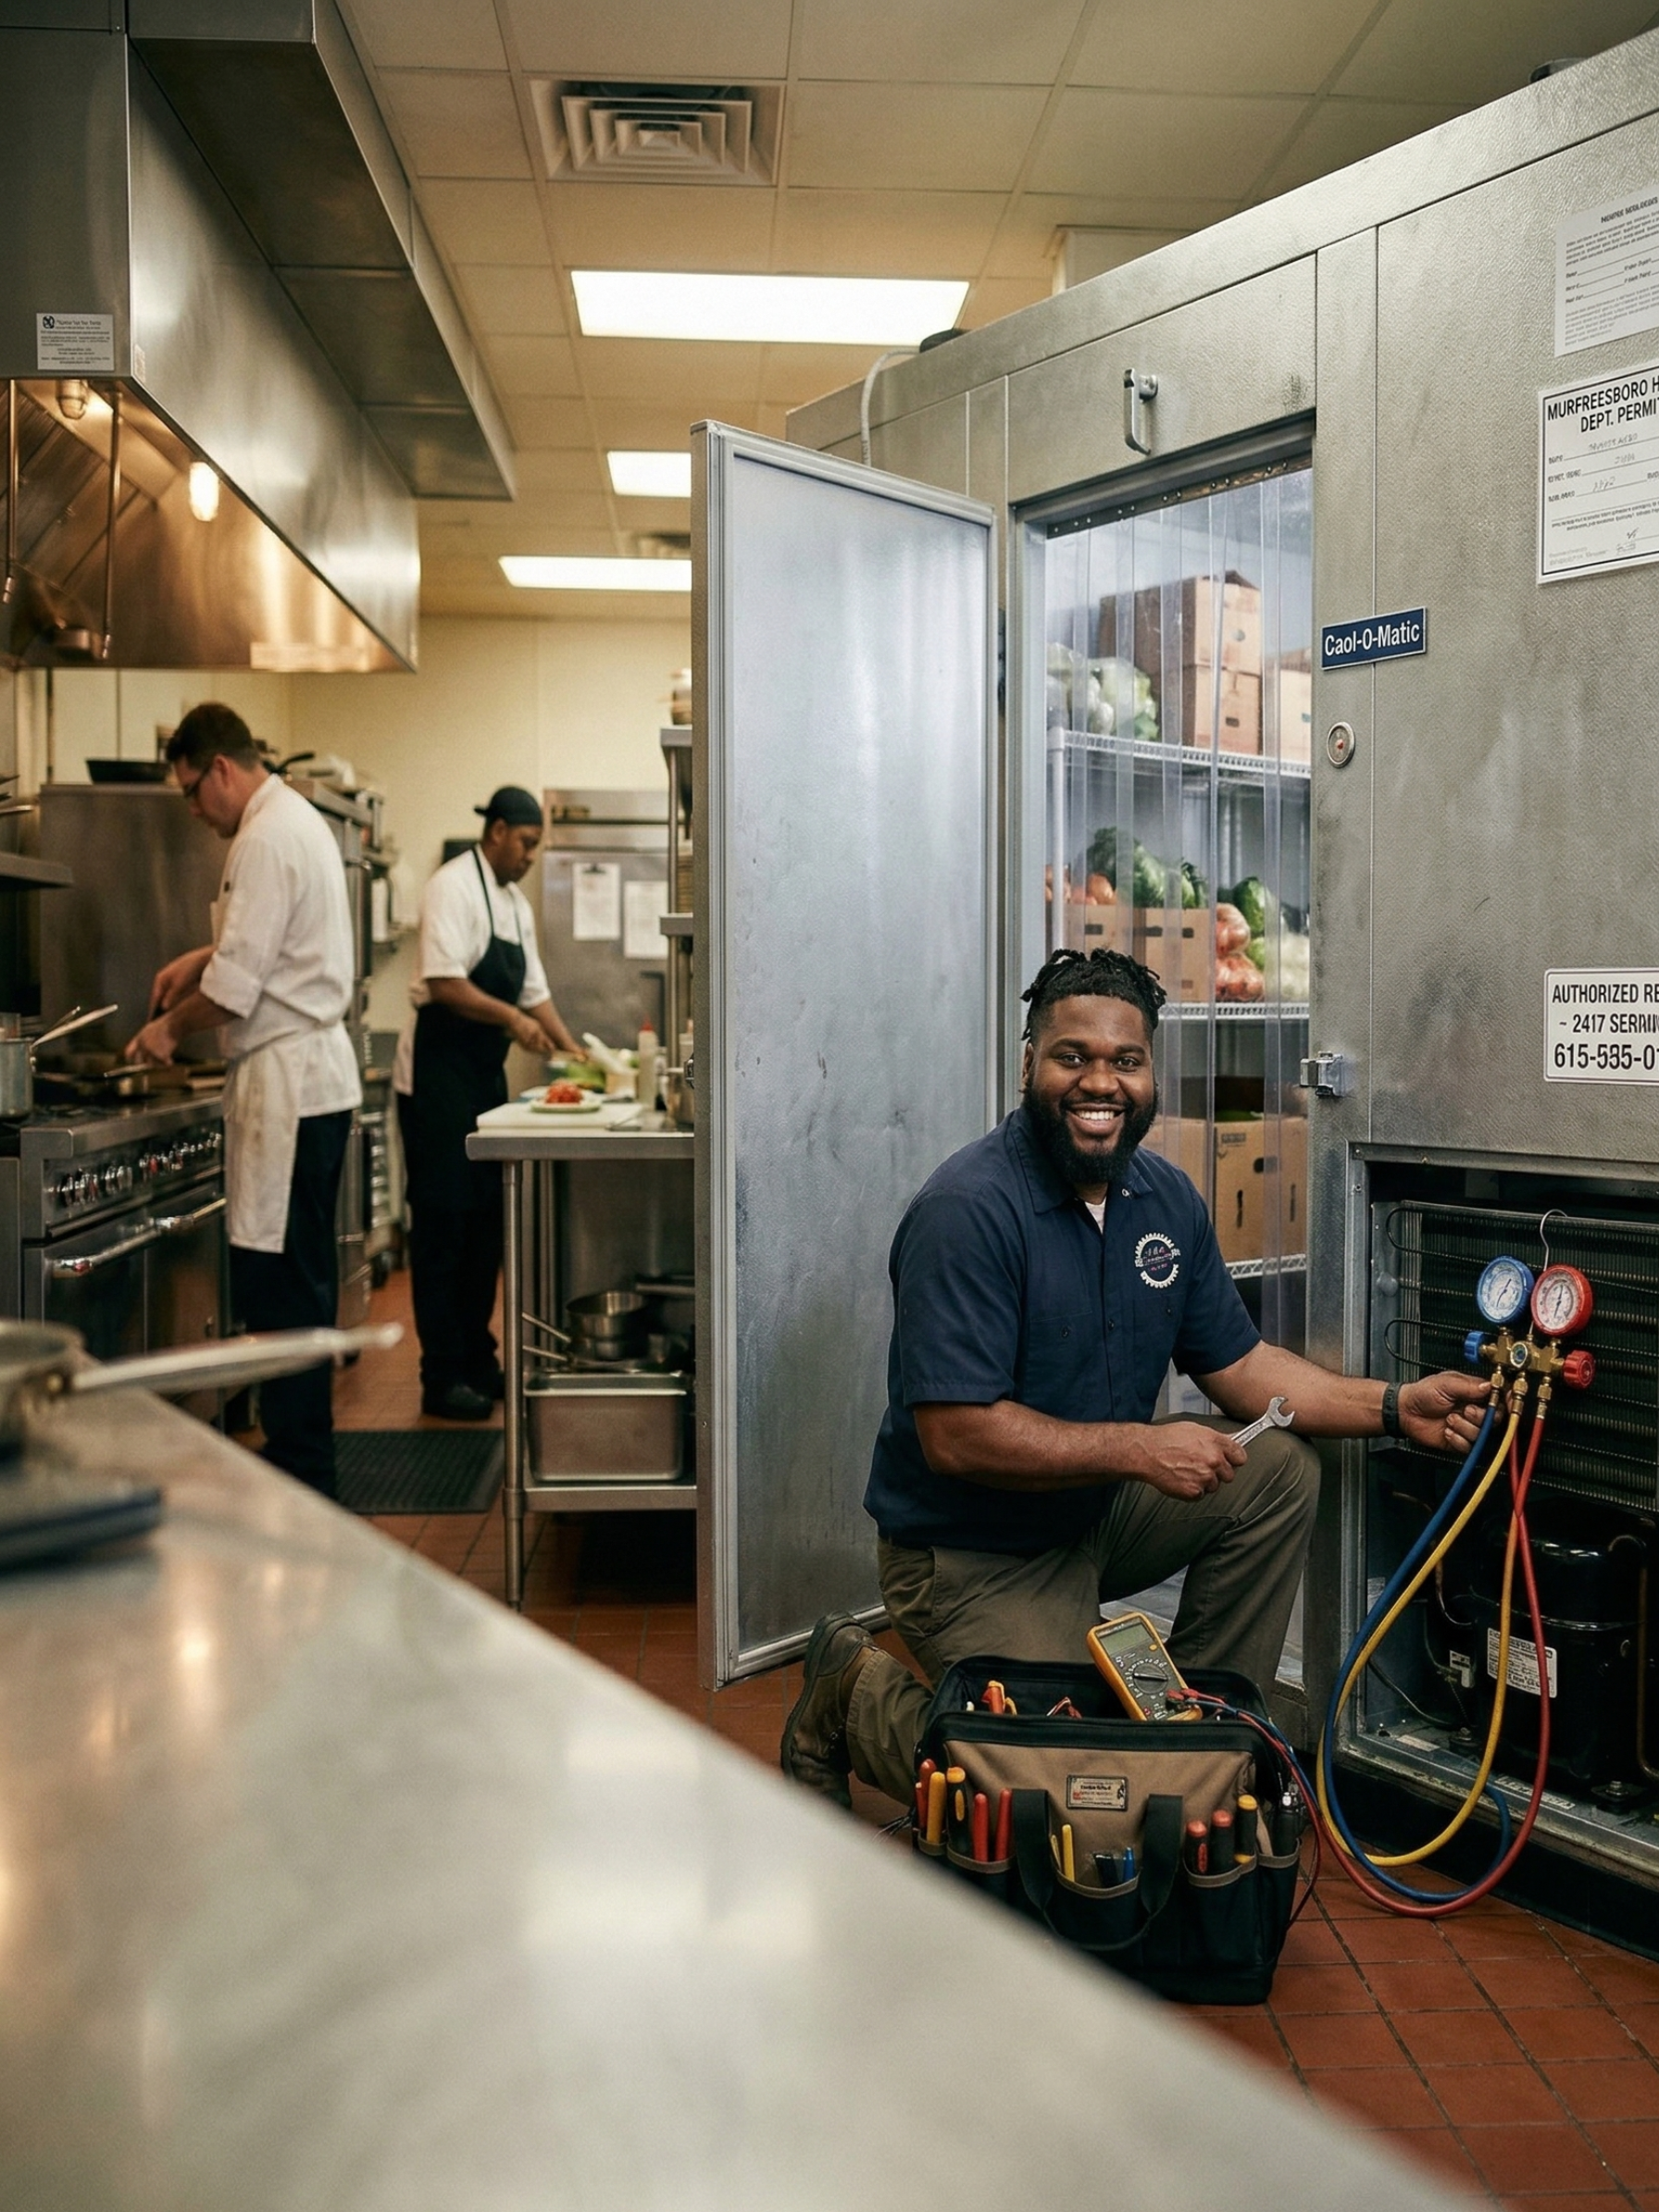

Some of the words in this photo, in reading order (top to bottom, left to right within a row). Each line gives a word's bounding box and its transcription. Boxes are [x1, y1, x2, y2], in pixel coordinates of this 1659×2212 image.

[1548, 379, 1648, 420] MURFREESBORO
[1581, 409, 1614, 432] DEPT.
[1617, 397, 1659, 423] PERMI
[1325, 620, 1420, 656] Caol-O-Matic
[1552, 984, 1639, 1003] AUTHORIZED
